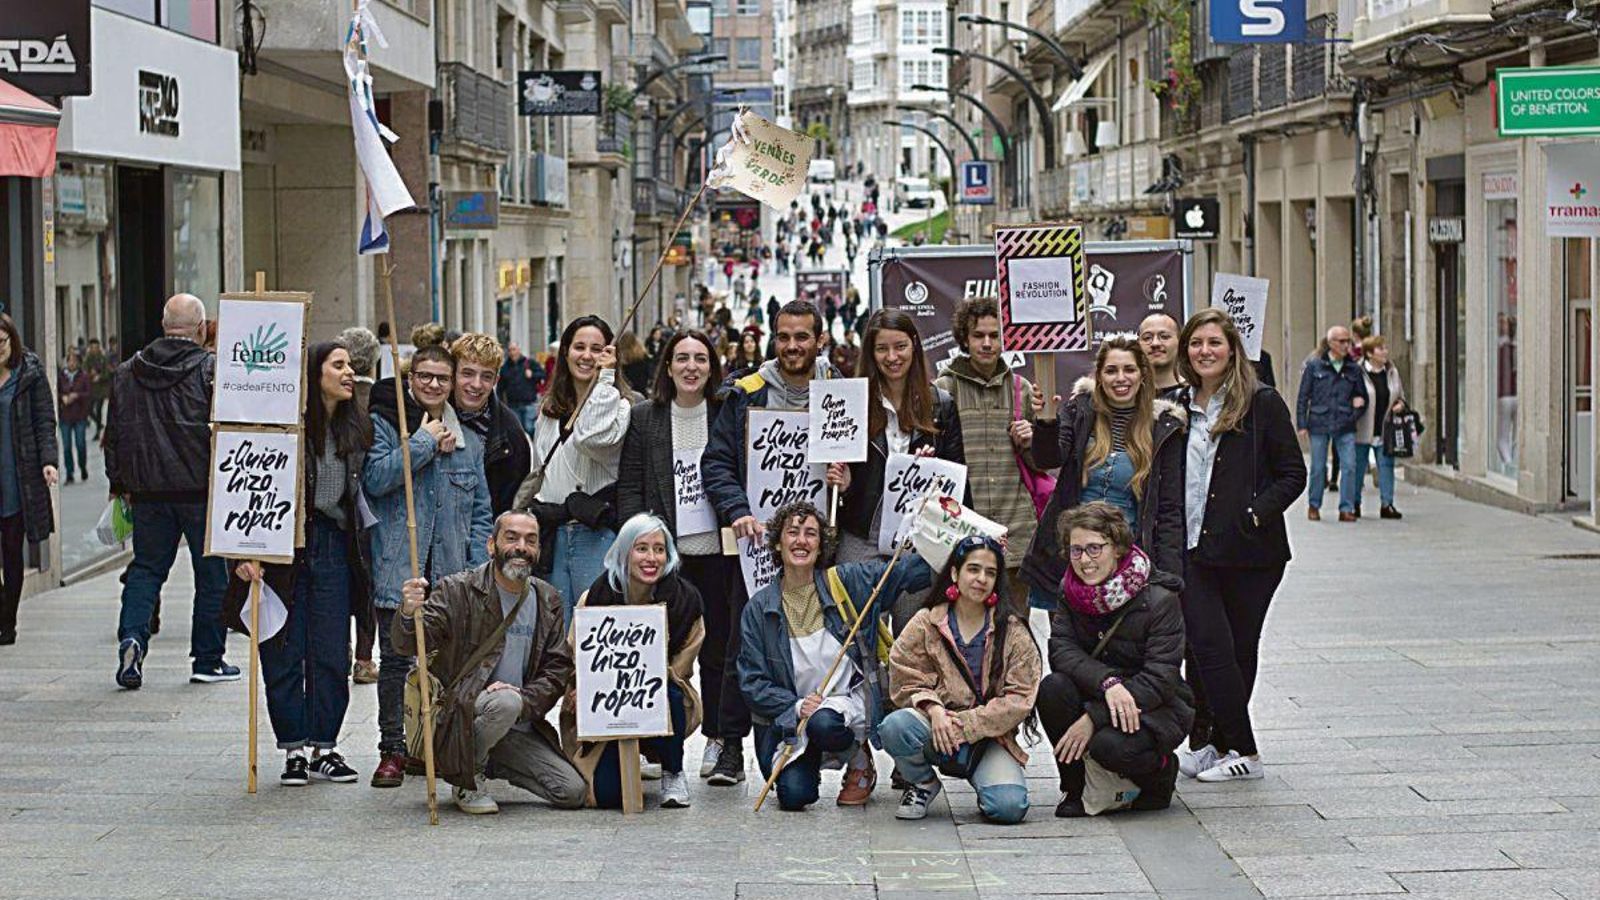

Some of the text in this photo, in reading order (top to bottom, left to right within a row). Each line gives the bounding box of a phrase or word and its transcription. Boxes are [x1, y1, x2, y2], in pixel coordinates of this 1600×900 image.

[1511, 87, 1600, 102] UNITED COLORS
[1511, 104, 1526, 116] OF
[745, 160, 786, 186] VERDE
[1015, 289, 1067, 298] REVOLUTION
[1023, 281, 1059, 290] FASHION
[231, 341, 287, 364] fento
[222, 382, 296, 394] #cadeaFENTO
[753, 418, 809, 450] ¿Quié
[219, 440, 289, 473] ¿Quién
[760, 445, 805, 472] hizo
[226, 467, 273, 493] hizo
[782, 465, 811, 489] mi
[248, 487, 278, 511] mi
[224, 501, 292, 537] ropa?
[580, 615, 657, 651] ¿Quién
[590, 644, 641, 672] hizo
[616, 663, 648, 690] mi
[591, 676, 664, 718] ropa?
